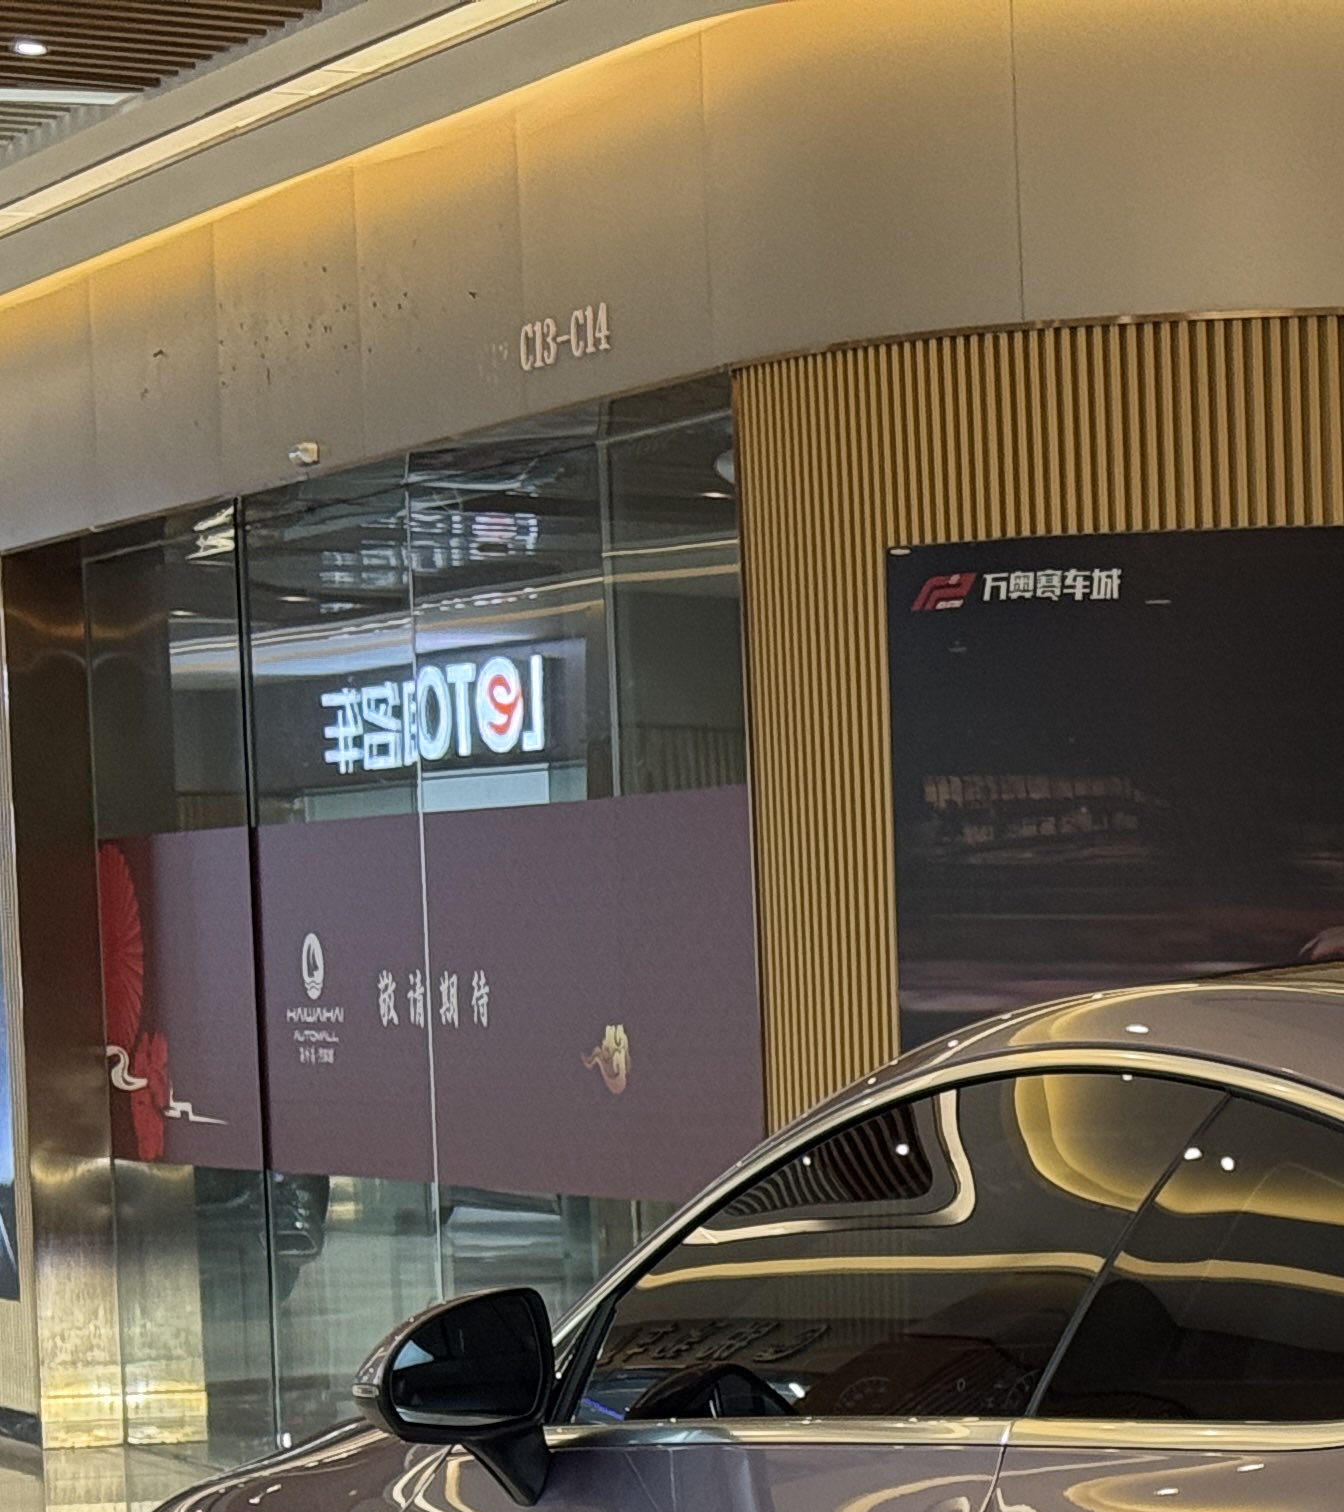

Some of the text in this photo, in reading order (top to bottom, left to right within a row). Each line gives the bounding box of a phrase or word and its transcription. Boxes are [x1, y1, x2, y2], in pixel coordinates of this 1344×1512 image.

[520, 302, 611, 371] C13-C14
[982, 567, 1123, 602] 万奥赛车城
[377, 968, 490, 1029] 敬请期待
